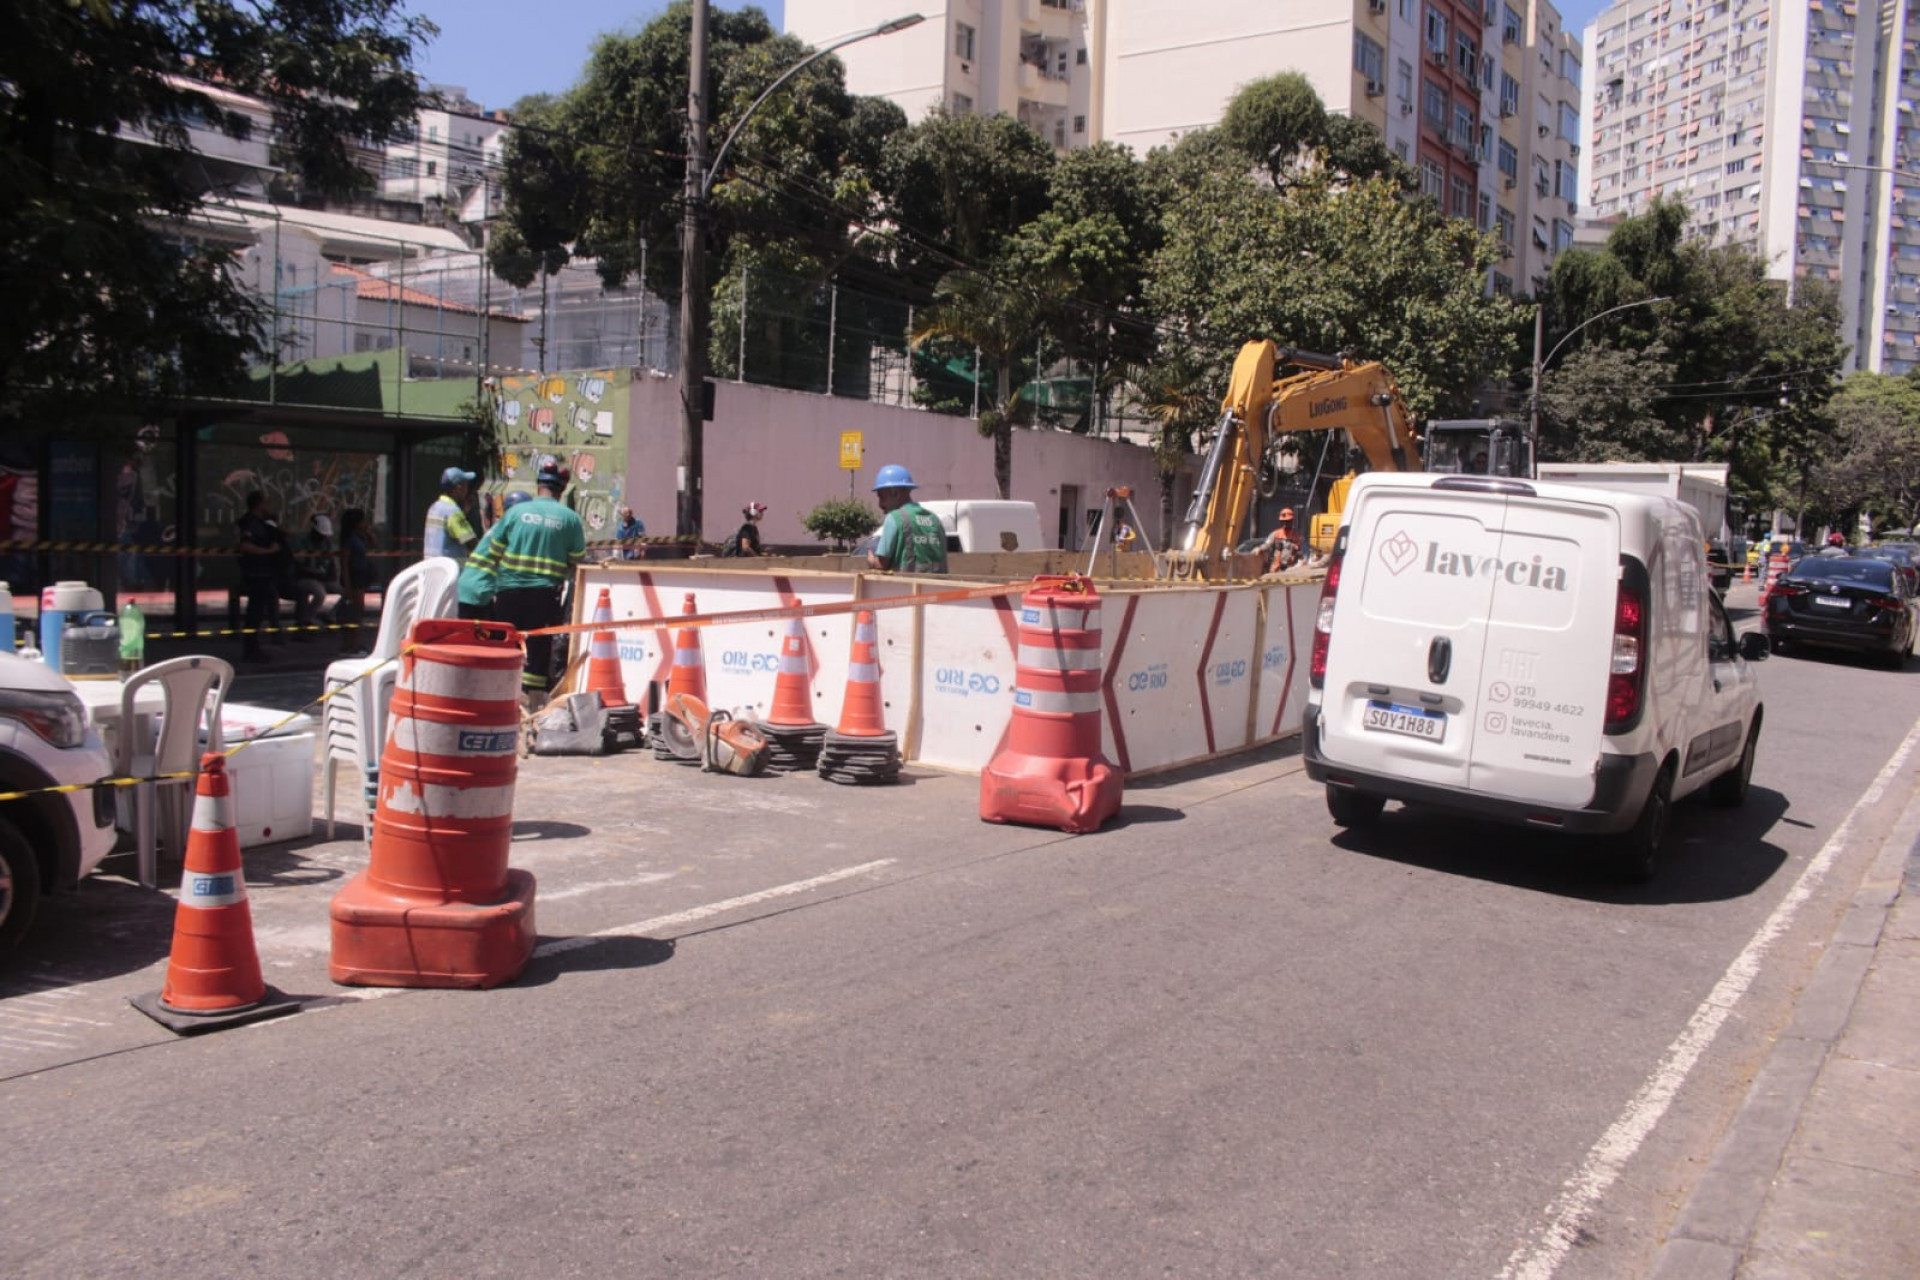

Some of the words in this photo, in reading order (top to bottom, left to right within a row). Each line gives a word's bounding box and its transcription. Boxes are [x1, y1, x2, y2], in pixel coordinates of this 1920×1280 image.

[1424, 541, 1567, 592] lavecia
[620, 646, 644, 661] RIO
[722, 650, 748, 667] RIO
[936, 668, 965, 686] RIO
[1150, 671, 1168, 689] RIO
[1513, 685, 1536, 697] (21)
[1513, 697, 1551, 711] 99949
[1553, 704, 1585, 717] 4622
[1369, 709, 1436, 736] SQY1H88
[462, 734, 495, 751] CET
[1510, 726, 1571, 743] lavanderia
